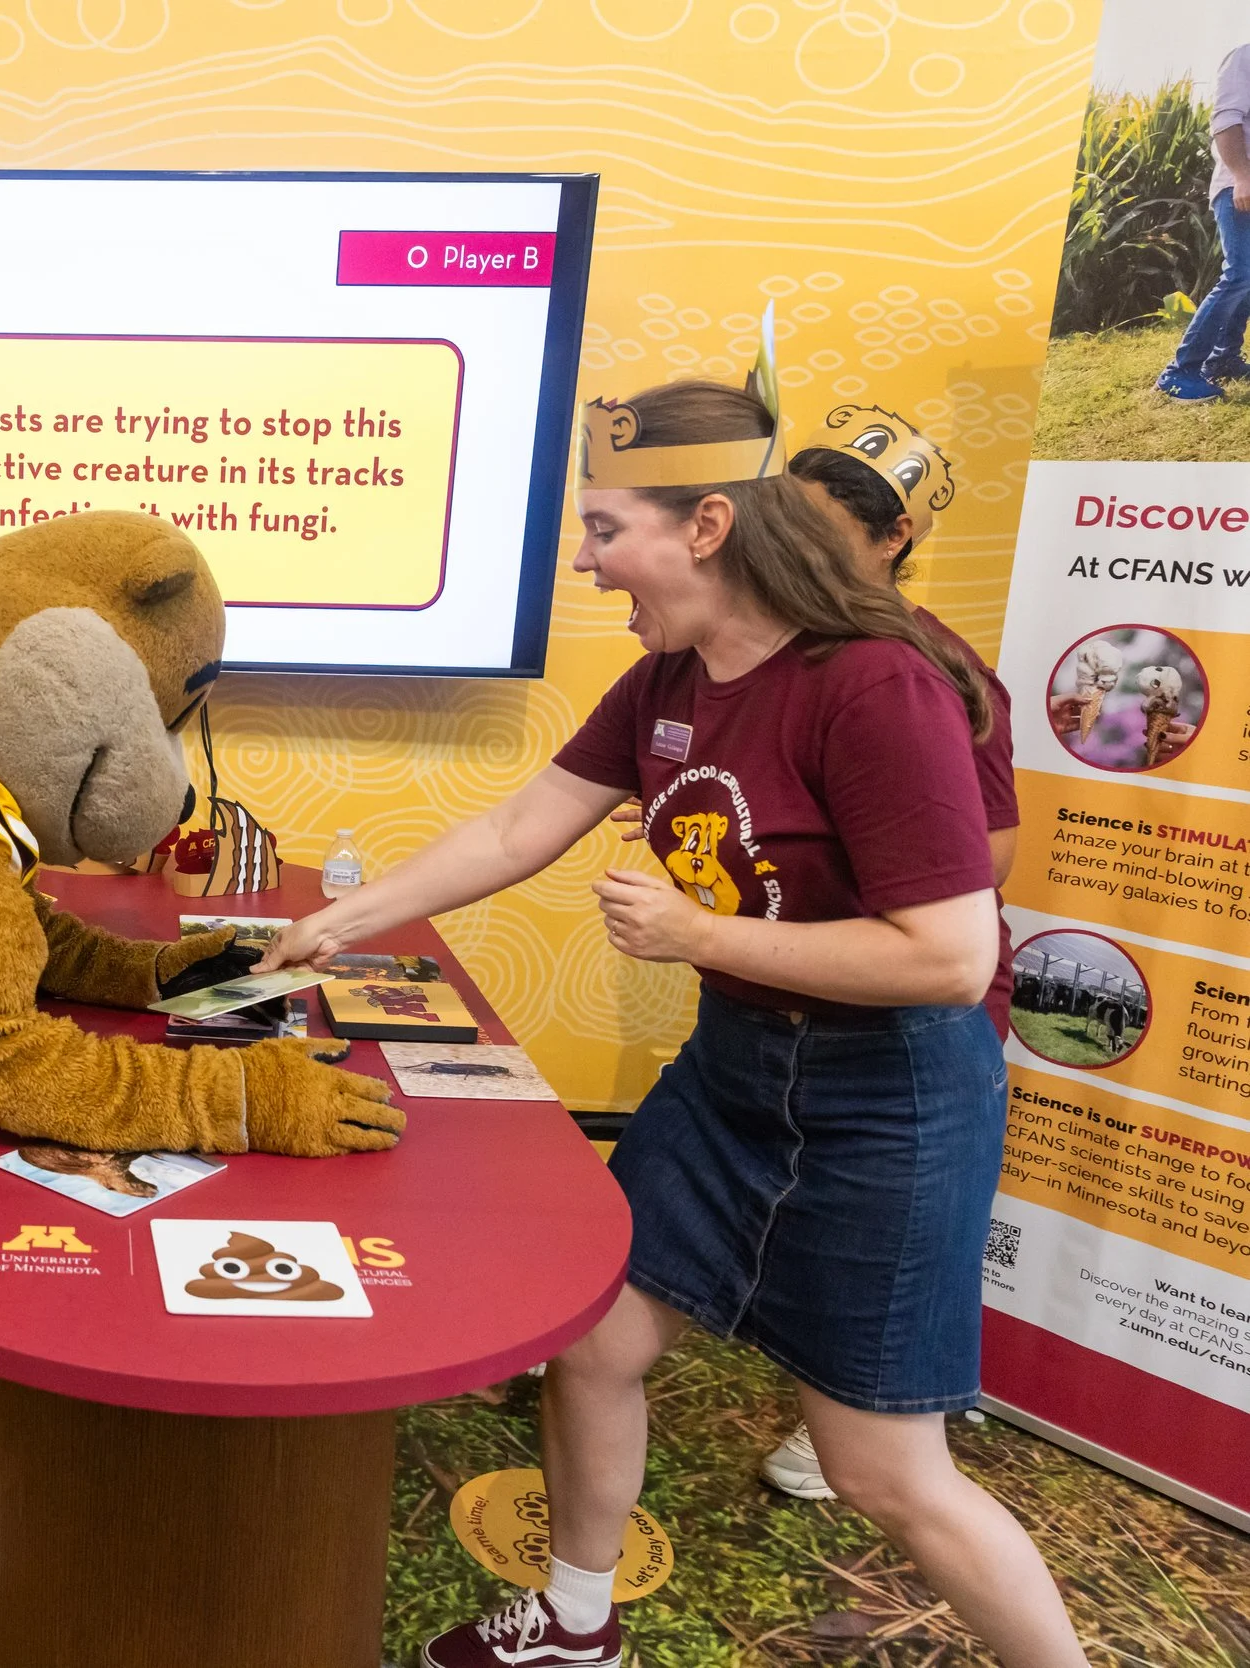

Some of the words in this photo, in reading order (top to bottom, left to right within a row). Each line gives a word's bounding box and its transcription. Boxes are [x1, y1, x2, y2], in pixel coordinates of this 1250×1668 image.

[443, 246, 516, 275] Player
[523, 247, 539, 269] B
[53, 411, 104, 433] are
[115, 407, 209, 444] trying
[220, 409, 252, 436] to
[262, 409, 332, 445] stop
[343, 407, 402, 438] this
[72, 456, 209, 483] creature
[220, 456, 247, 484] in
[258, 458, 296, 485] its
[307, 456, 405, 487] tracks
[171, 503, 237, 531] with
[249, 502, 337, 541] fungi.
[1075, 495, 1250, 533] Discove
[1067, 555, 1100, 578] At
[1108, 556, 1214, 585] CFANS
[1223, 568, 1250, 587] w
[643, 791, 667, 840] OLLEGE
[1057, 807, 1134, 831] Science
[1137, 820, 1153, 835] is
[1156, 824, 1250, 853] STIMULA
[1053, 828, 1117, 850] Amaze
[1121, 841, 1161, 859] your
[1165, 848, 1214, 869] brain
[1219, 859, 1239, 874] at
[1048, 868, 1119, 895] faraway
[1123, 885, 1198, 910] galaxies
[1204, 899, 1223, 914] to
[1051, 851, 1108, 870] where
[1113, 861, 1243, 900] mind-blowing
[1194, 980, 1250, 1006] Scien
[1190, 1001, 1239, 1026] From
[1182, 1045, 1250, 1072] growin
[1178, 1065, 1250, 1098] starting
[1009, 1104, 1052, 1128] From
[1058, 1121, 1120, 1150] climate
[1125, 1144, 1195, 1173] change
[1201, 1164, 1220, 1181] to
[1012, 1086, 1084, 1117] Science
[1087, 1107, 1101, 1123] is
[1105, 1117, 1137, 1134] our
[1140, 1125, 1250, 1170] SUPERPOW
[1006, 1124, 1066, 1151] CFANS
[1070, 1145, 1152, 1181] scientists
[1156, 1174, 1186, 1191] are
[1192, 1185, 1244, 1214] using
[1003, 1144, 1123, 1192] super-science
[1128, 1185, 1174, 1209] skills
[1180, 1200, 1198, 1217] to
[1203, 1210, 1250, 1234] save
[1066, 1181, 1157, 1224] Minnesota
[1161, 1217, 1198, 1238] and
[1203, 1228, 1250, 1256] beyo
[13, 1263, 101, 1275] MINNESOTA
[991, 1269, 1001, 1278] to
[991, 1279, 1015, 1292] more
[1080, 1268, 1142, 1299] Discover
[1145, 1292, 1169, 1310] the
[1172, 1305, 1239, 1339] amazing
[1154, 1278, 1195, 1304] Want
[1200, 1296, 1216, 1310] to
[1095, 1293, 1136, 1315] every
[1139, 1308, 1166, 1327] day
[1169, 1321, 1184, 1333] at
[466, 1495, 490, 1525] time!
[630, 1511, 655, 1536] Gop
[473, 1528, 509, 1565] Game
[647, 1537, 667, 1566] play
[625, 1564, 660, 1588] Let's
